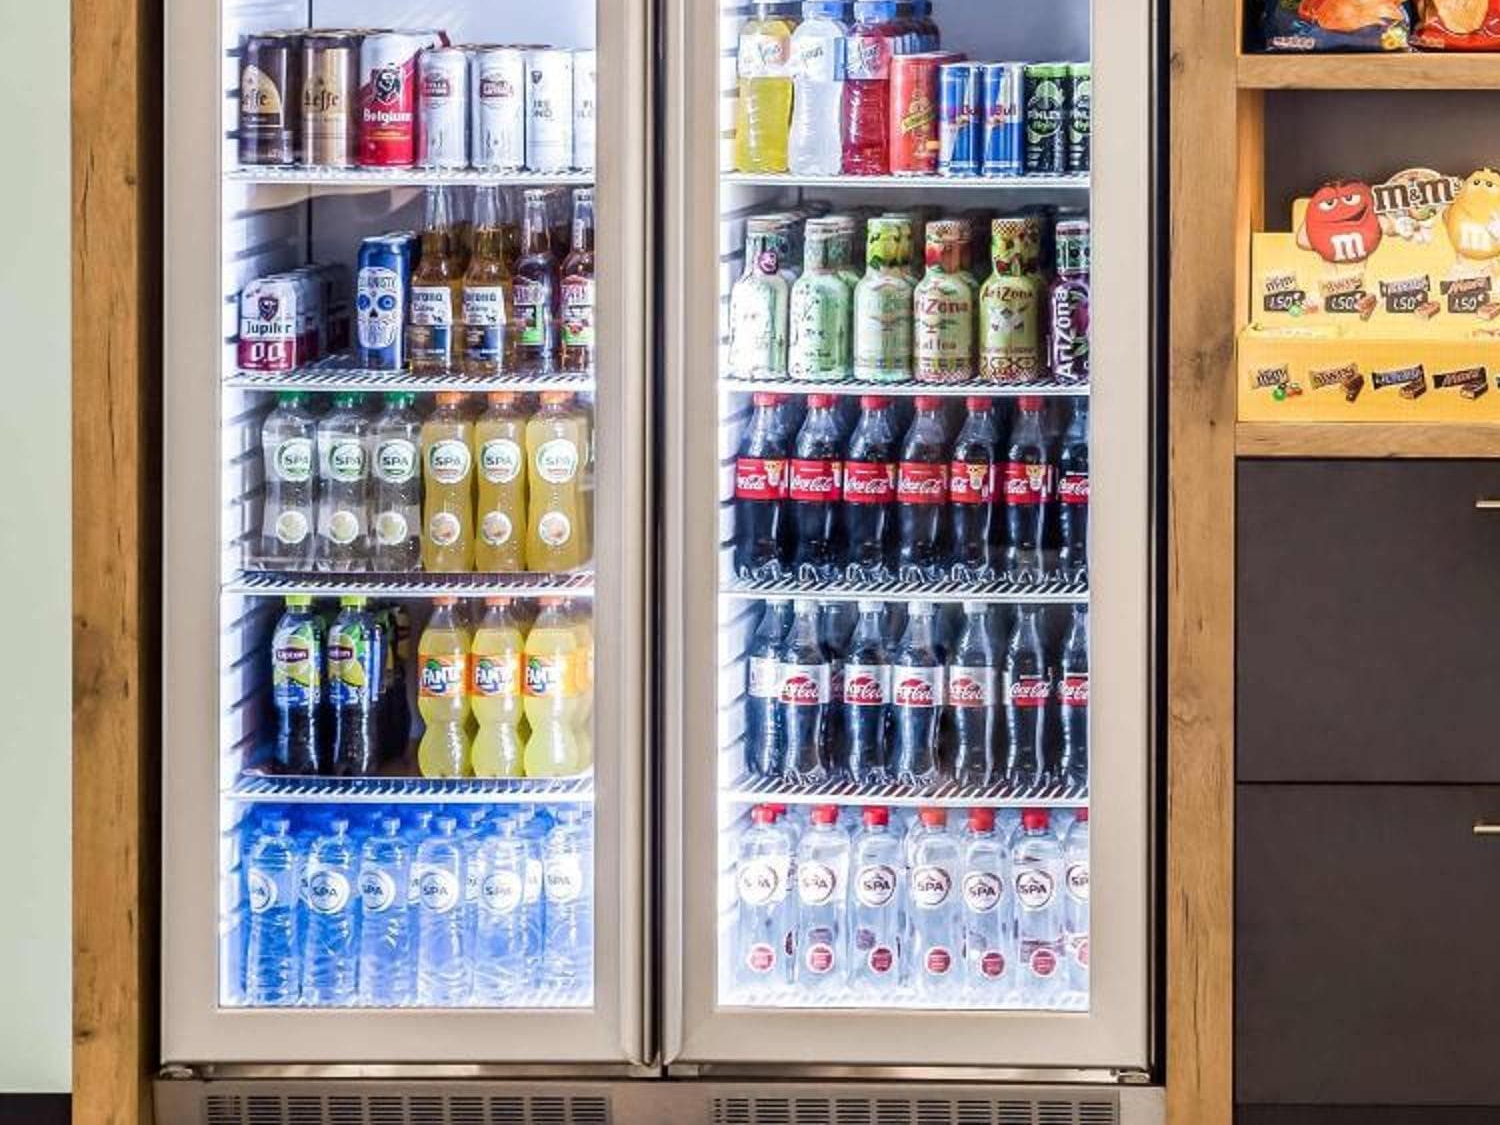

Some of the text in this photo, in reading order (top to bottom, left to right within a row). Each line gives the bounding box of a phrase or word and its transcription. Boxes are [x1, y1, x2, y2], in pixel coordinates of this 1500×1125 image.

[863, 878, 892, 891] SPA
[918, 879, 945, 893] SPA
[968, 884, 997, 898] SPA
[1019, 883, 1048, 895] SPA
